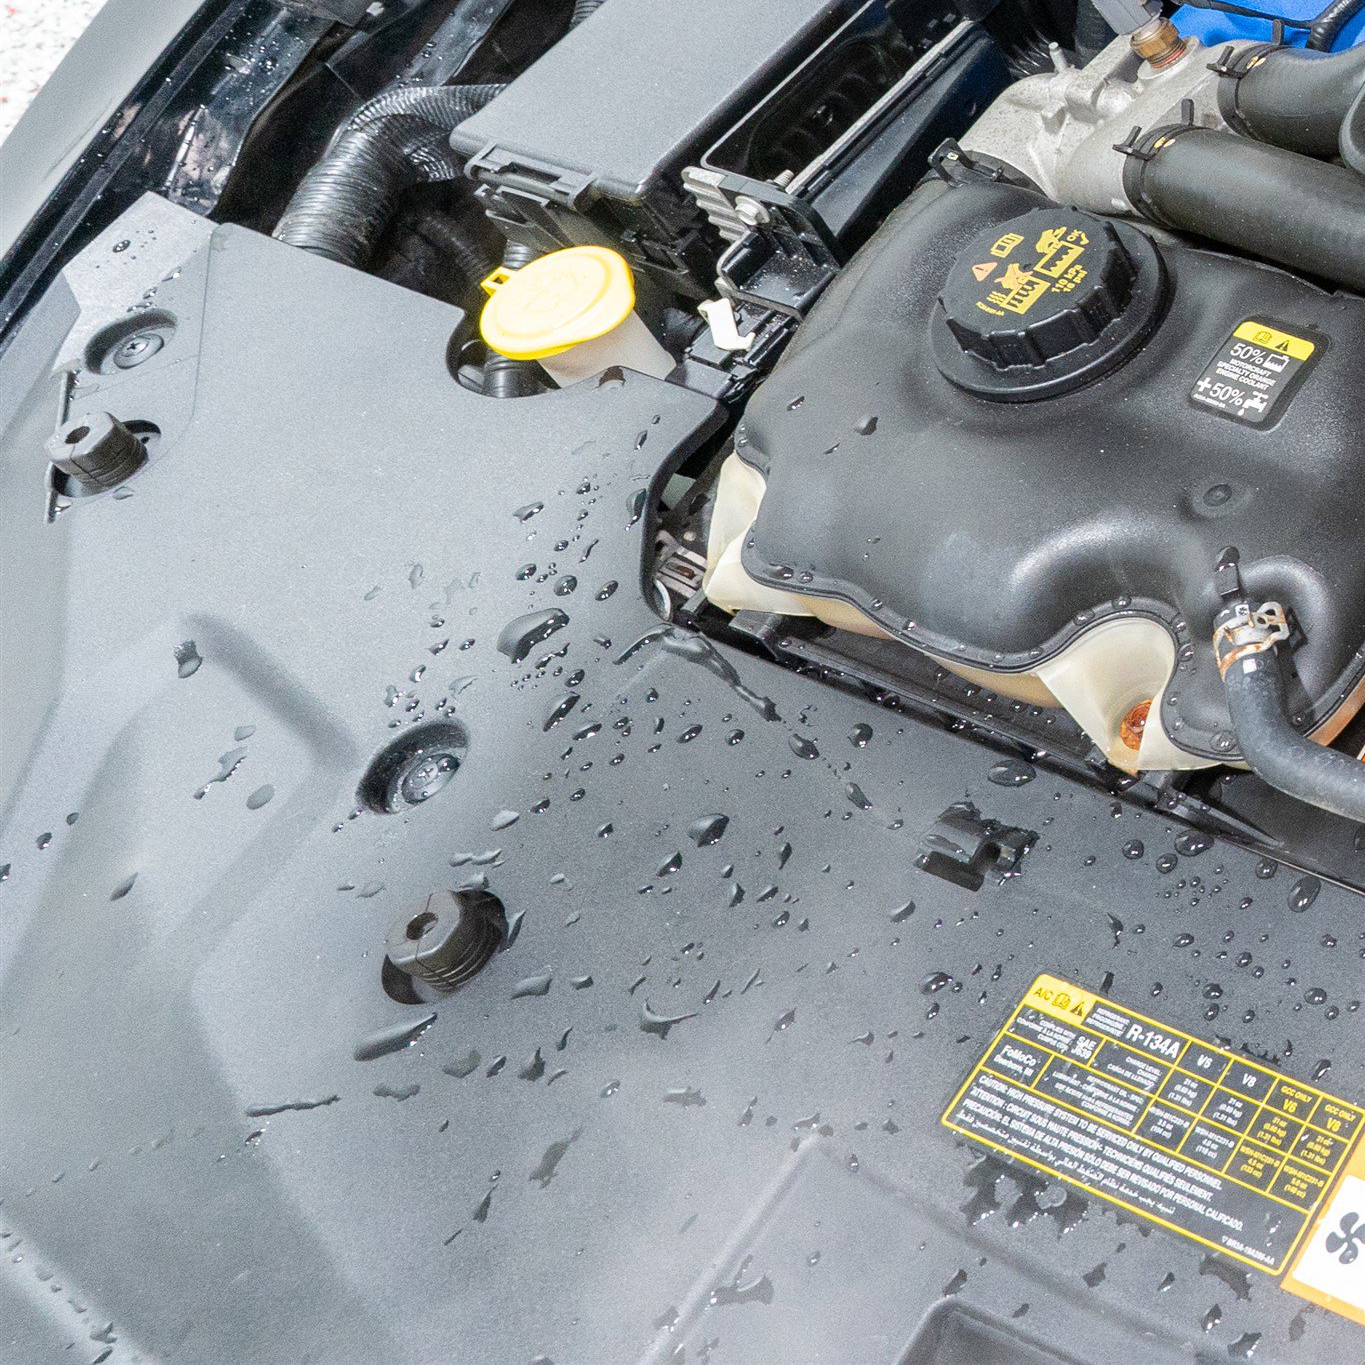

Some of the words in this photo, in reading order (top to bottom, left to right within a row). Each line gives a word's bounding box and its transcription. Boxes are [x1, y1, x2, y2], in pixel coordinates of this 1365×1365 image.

[1066, 229, 1083, 242] OK
[1075, 270, 1088, 285] psi
[1051, 278, 1068, 293] 110
[1230, 343, 1266, 364] 50%
[1217, 361, 1250, 377] SPECIALTY
[1249, 372, 1276, 386] ORANGE
[1230, 359, 1272, 378] MOTORCRAFT
[1216, 368, 1239, 380] ENGINE
[1239, 376, 1269, 391] COOLANT
[1033, 987, 1053, 1000] A/C
[1076, 1036, 1096, 1050] SAE
[1126, 1024, 1179, 1057] R-134A
[1000, 1045, 1036, 1066] FoMoCo
[1197, 1054, 1212, 1068] V6
[1242, 1073, 1256, 1087] V8
[1294, 1091, 1311, 1102] ONLY
[1006, 1103, 1032, 1120] CIRCUIT
[1283, 1098, 1297, 1112] V6
[1338, 1109, 1355, 1121] ONLY
[1006, 1087, 1024, 1100] HIGH
[1021, 1094, 1055, 1113] PRESSURE
[1053, 1108, 1079, 1124] SYSTEM
[1125, 1140, 1145, 1154] ONLY
[1151, 1152, 1185, 1172] QUALIFIED
[1042, 1134, 1059, 1147] ALTA
[1116, 1167, 1131, 1179] SER
[1129, 1173, 1161, 1192] REVISADO
[1168, 1190, 1205, 1214] PERSONAL
